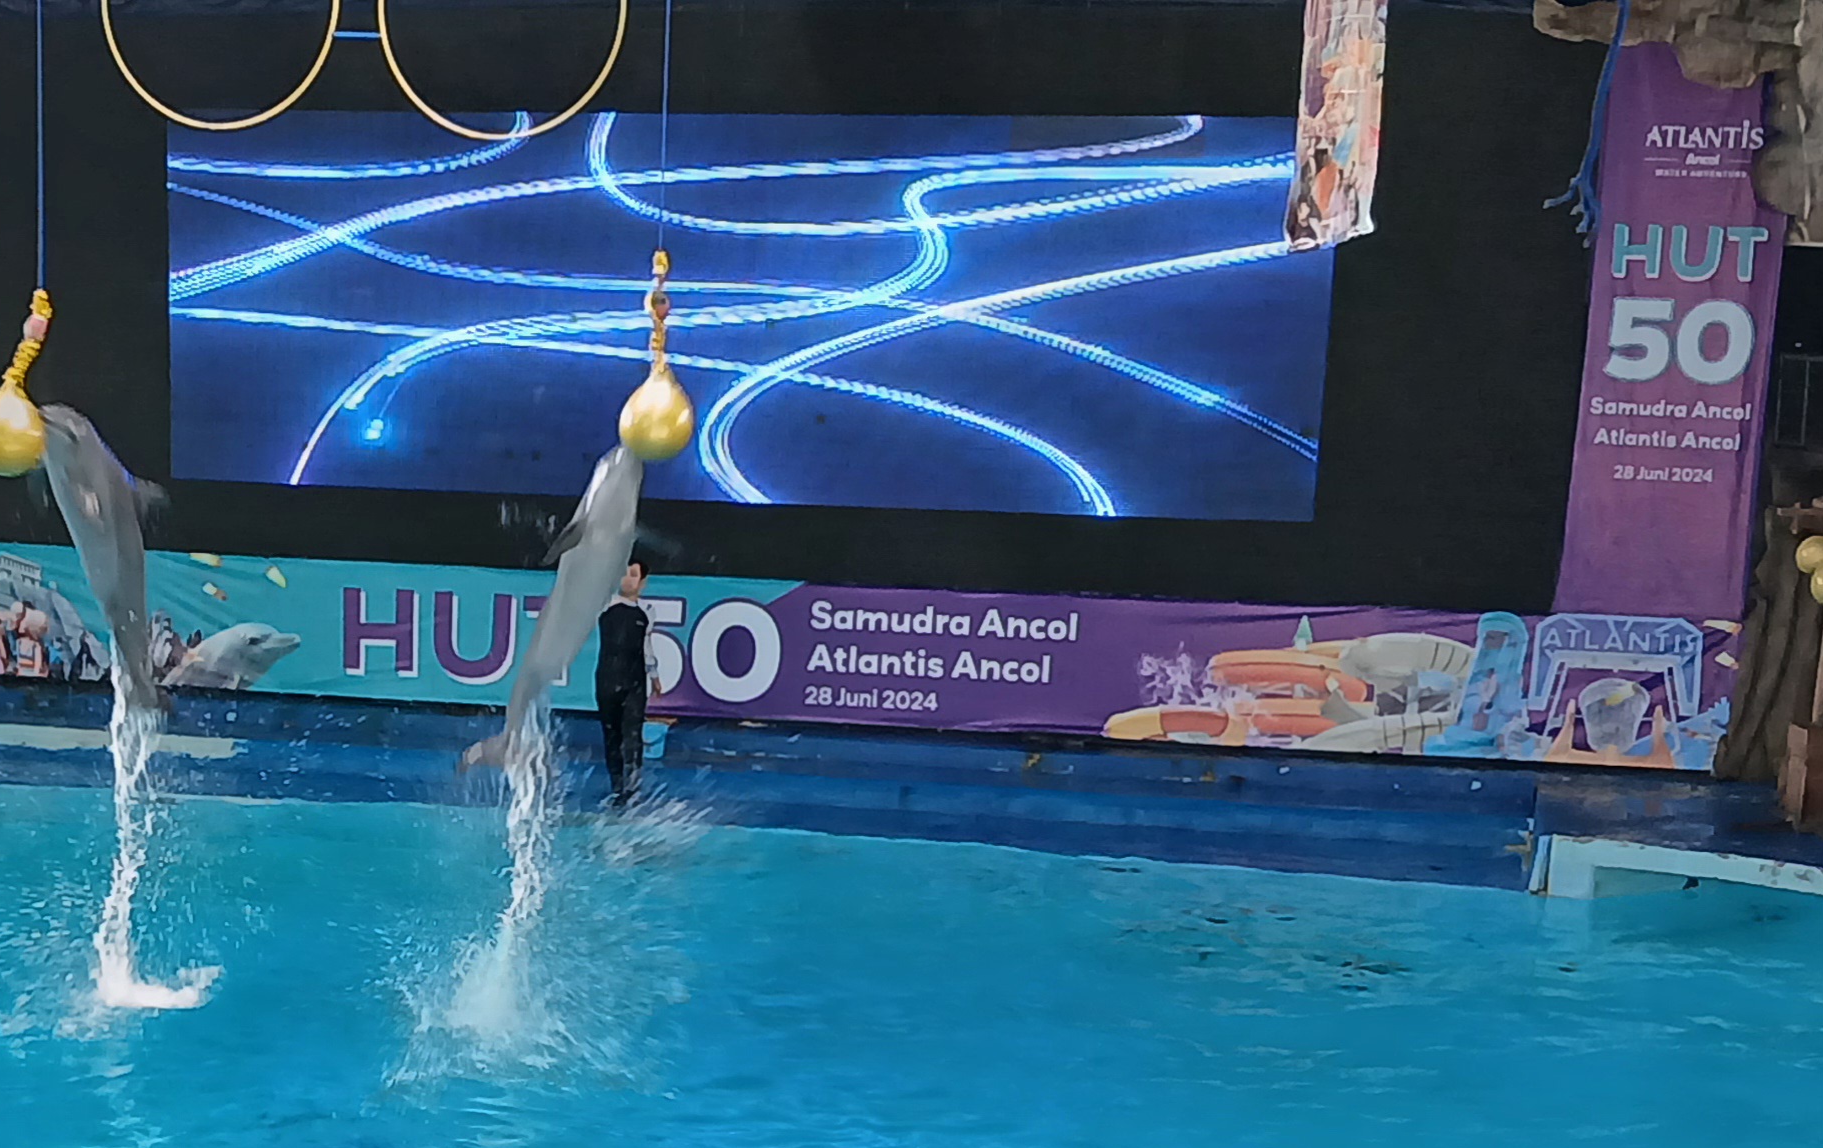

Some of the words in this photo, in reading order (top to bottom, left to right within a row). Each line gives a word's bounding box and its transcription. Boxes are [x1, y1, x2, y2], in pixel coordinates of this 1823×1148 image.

[1644, 119, 1764, 150] ATLANTIS
[1611, 223, 1769, 283] HUT
[1602, 296, 1756, 385] 50
[1589, 396, 1687, 419] Samudra
[1691, 400, 1752, 421] Ancol
[1593, 427, 1677, 449] Atlantis
[1680, 430, 1742, 452] Ancol
[1613, 464, 1635, 480] 28
[1636, 466, 1669, 482] Juni
[1671, 468, 1714, 483] 2024
[809, 600, 971, 637] Samudra
[977, 608, 1079, 642] Ancol
[806, 643, 945, 679] Atlantis
[950, 650, 1052, 684] Ancol
[804, 685, 833, 706] 28
[835, 688, 878, 709] Juni
[881, 690, 939, 712] 2024
